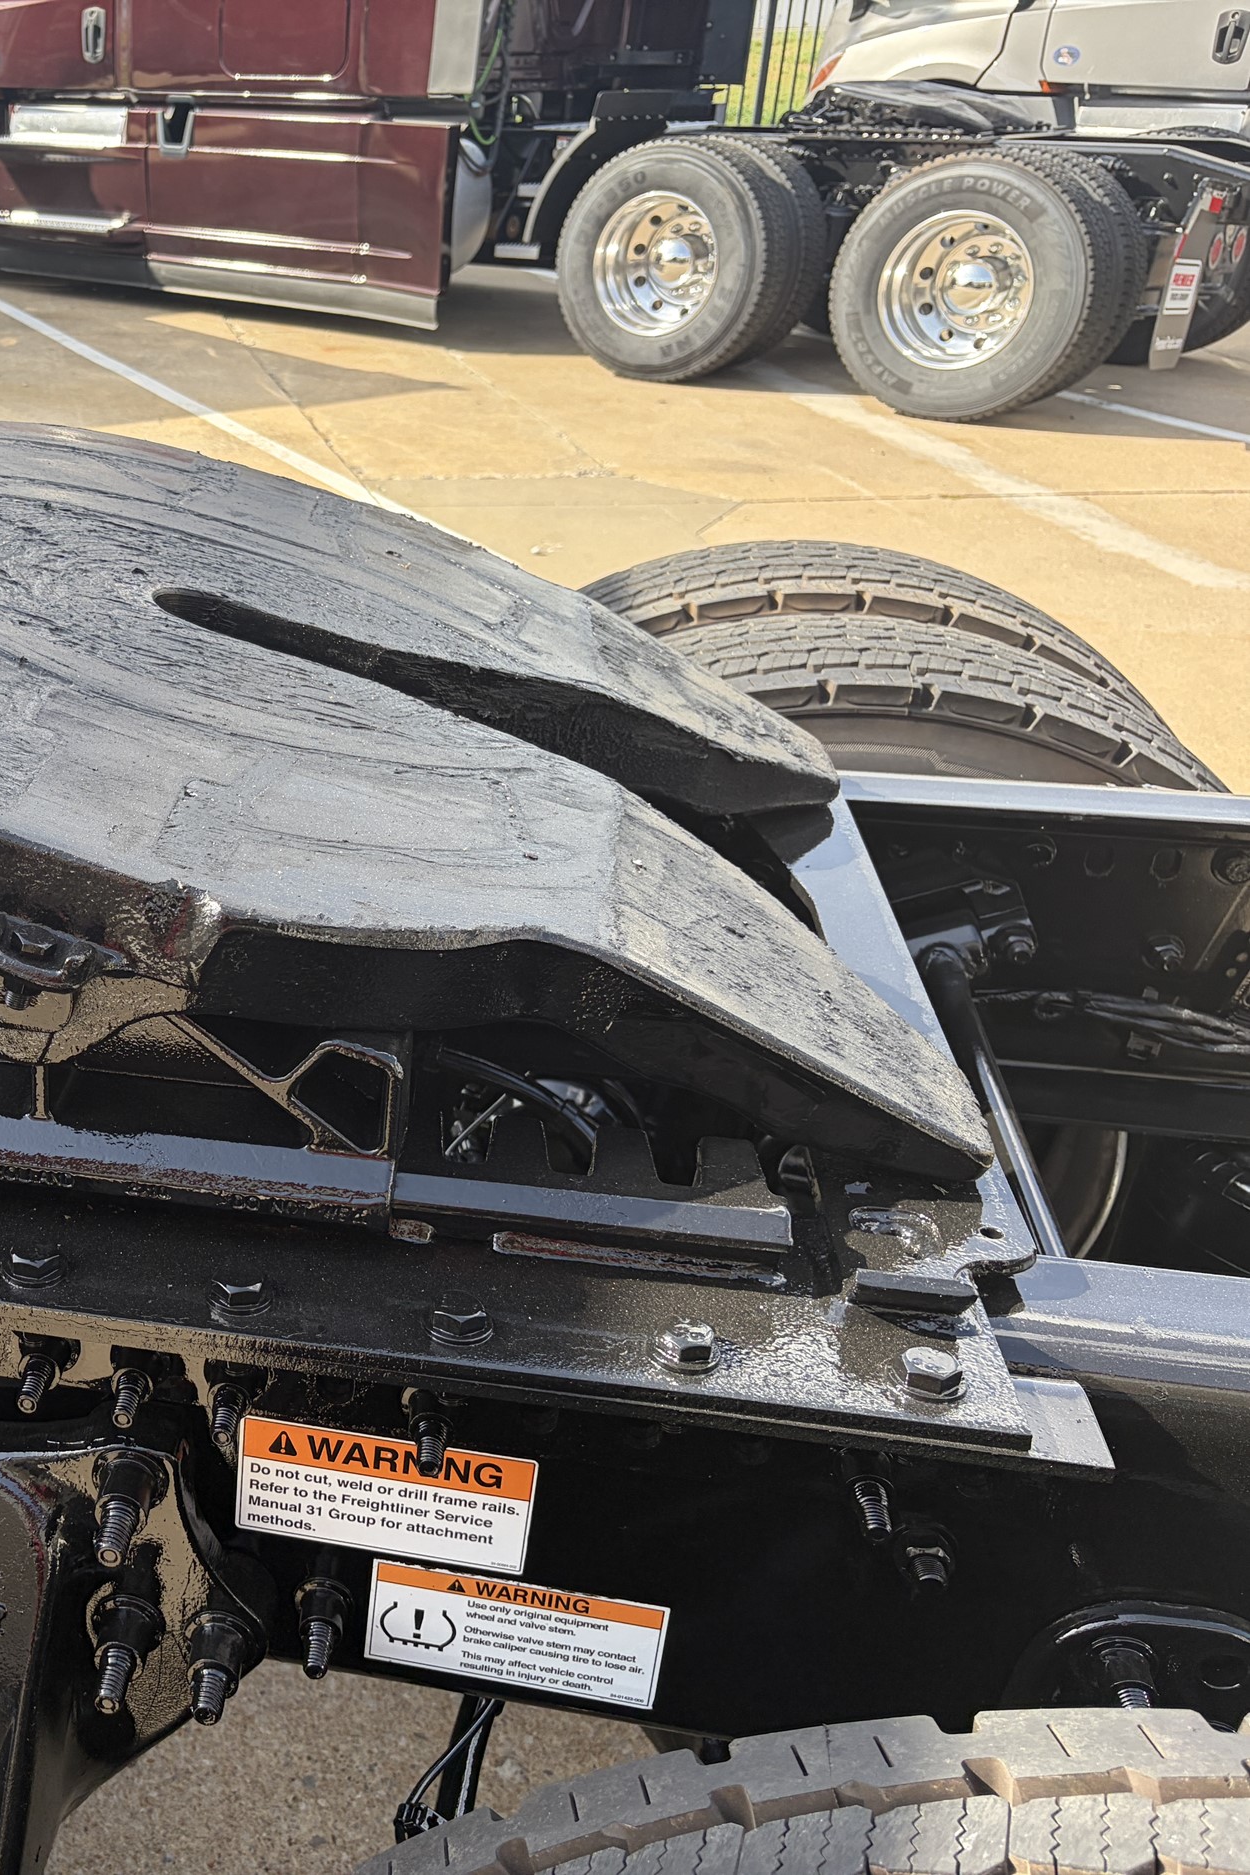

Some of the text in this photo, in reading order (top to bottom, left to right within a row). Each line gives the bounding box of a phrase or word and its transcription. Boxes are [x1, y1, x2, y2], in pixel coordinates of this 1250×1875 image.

[961, 177, 1033, 211] POWER
[307, 1435, 503, 1489] WARNNG
[249, 1479, 493, 1528] Refer to the Freightliner Service
[251, 1463, 519, 1516] Do not cut, weld or drill frame rails.
[247, 1512, 316, 1532] methods.
[248, 1495, 494, 1545] Manual 31 Group for attachment
[475, 1581, 590, 1614] WARNING
[466, 1611, 576, 1637] wheel and valve stem.
[467, 1600, 609, 1632] Use only original equipment
[463, 1635, 645, 1675] brake caliper causing tire to lose air.
[464, 1625, 637, 1663] Otherwise valve stem may contact
[459, 1661, 593, 1692] resulting in injury or death.
[461, 1650, 614, 1685] This may affect vehicle control
